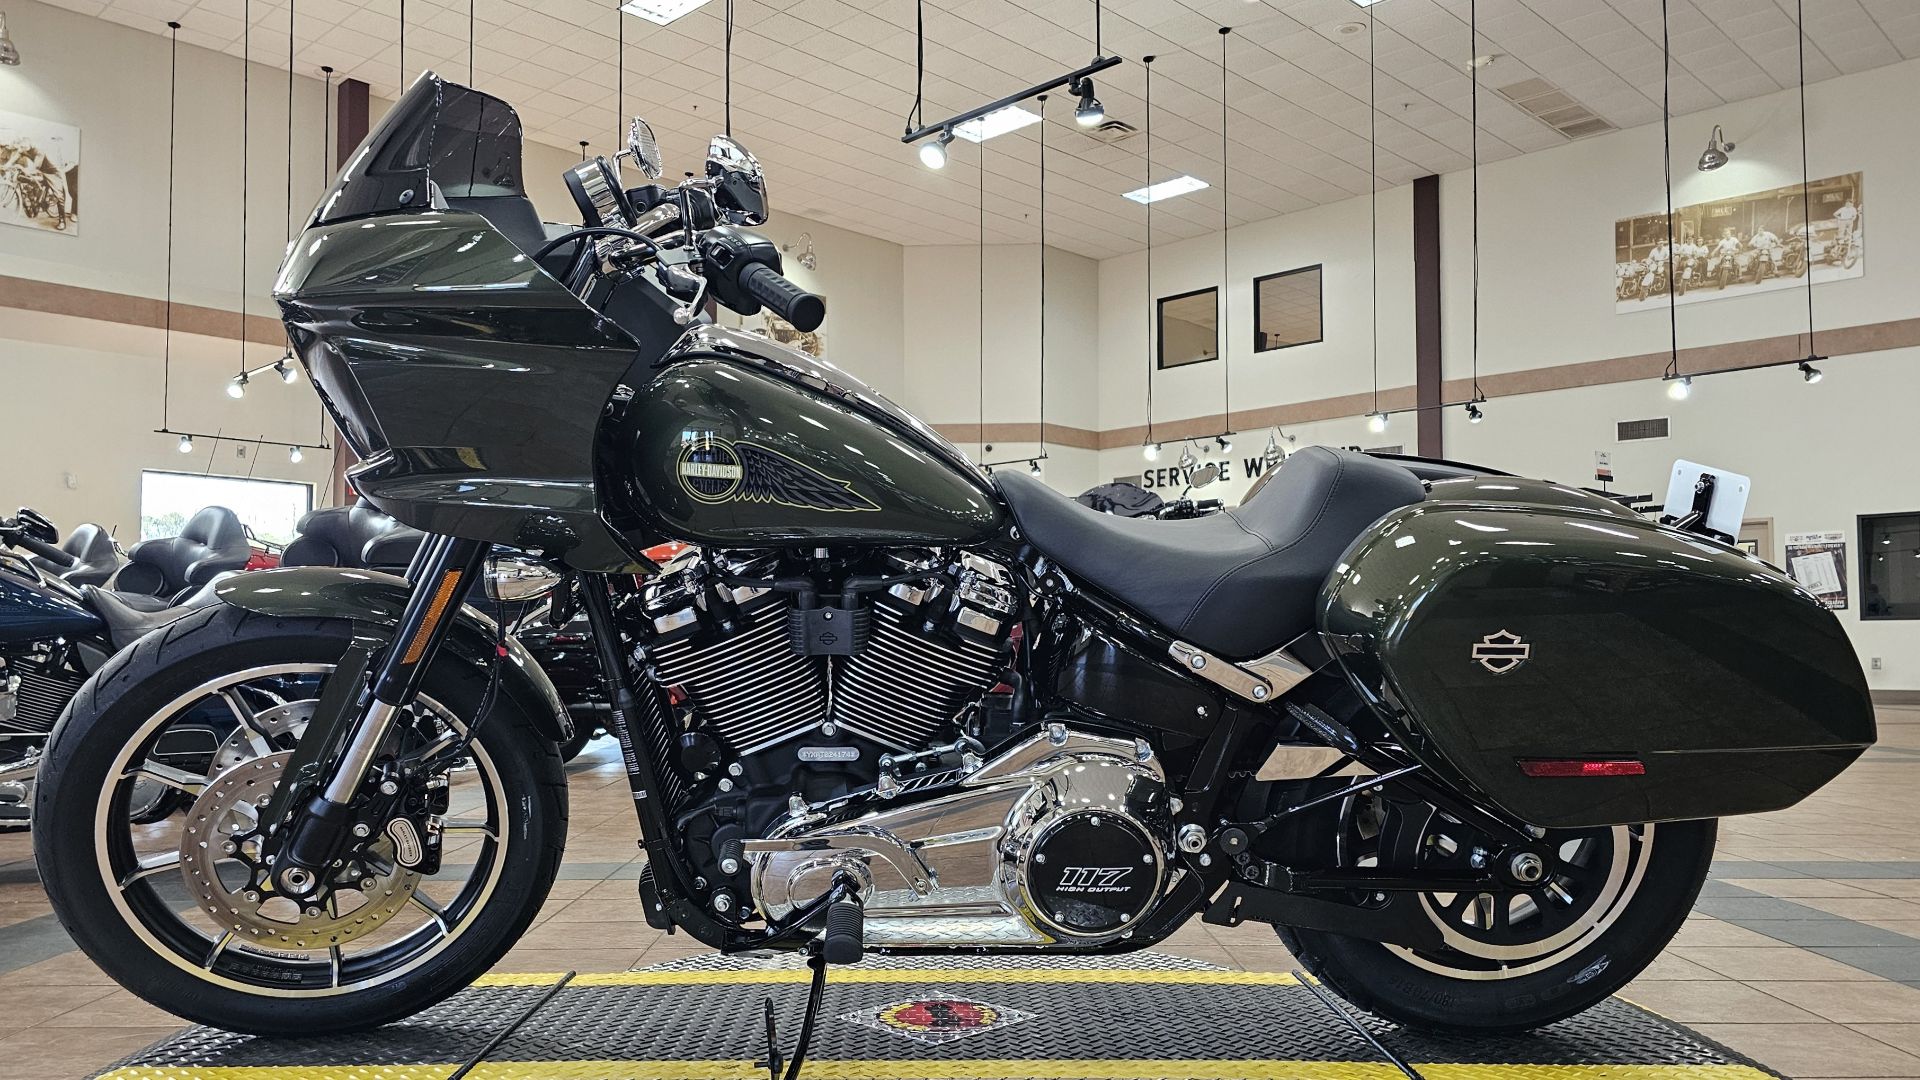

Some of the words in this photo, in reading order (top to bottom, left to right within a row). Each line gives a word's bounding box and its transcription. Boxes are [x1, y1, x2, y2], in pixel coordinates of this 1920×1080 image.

[681, 462, 741, 479] HARLEY-DAVIDSON
[1143, 461, 1230, 489] SERVE
[692, 479, 729, 494] CYCLES
[1060, 867, 1133, 886] 117
